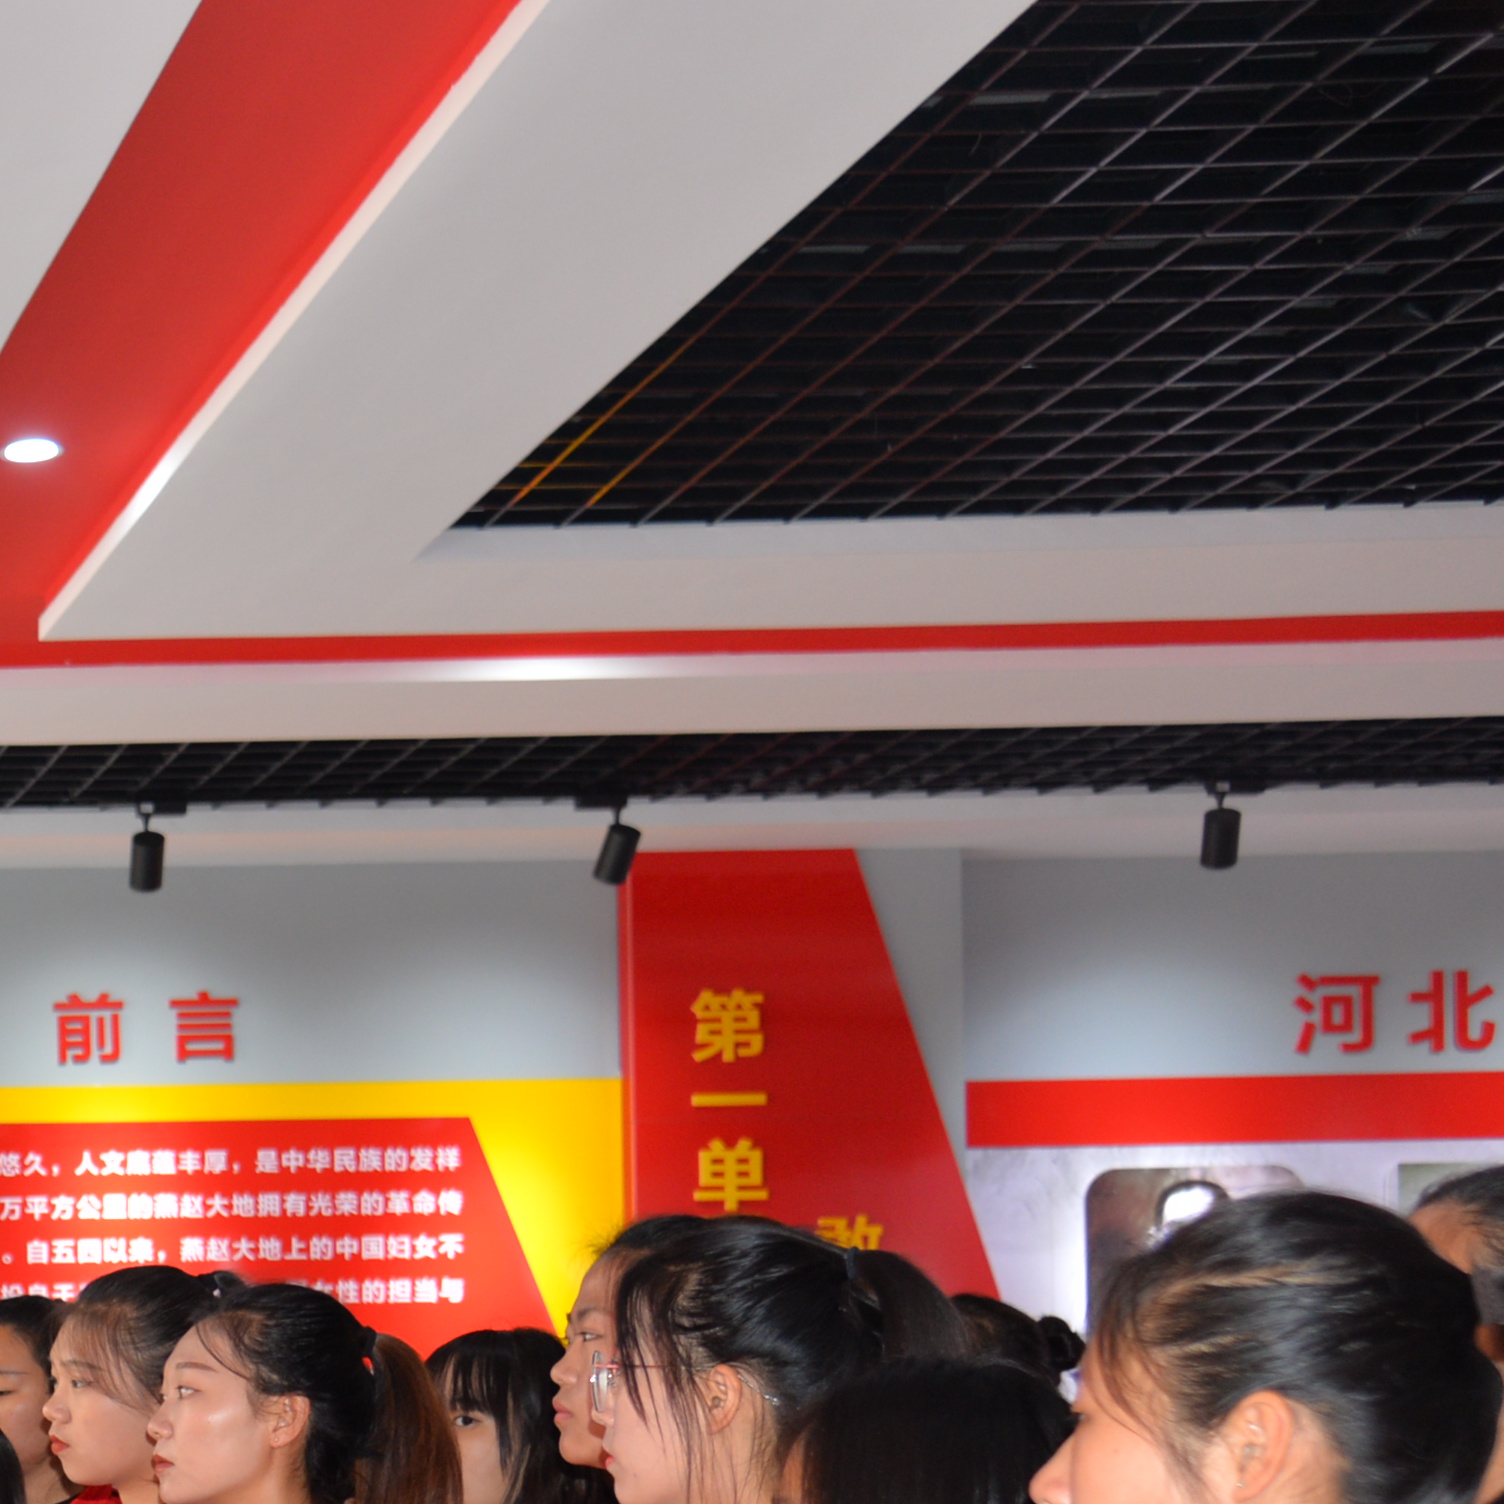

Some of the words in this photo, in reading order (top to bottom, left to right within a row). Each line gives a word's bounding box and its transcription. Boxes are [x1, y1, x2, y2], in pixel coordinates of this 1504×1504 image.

[53, 991, 241, 1067] 前言
[1293, 969, 1496, 1055] 河北
[691, 987, 769, 1213] 第一单
